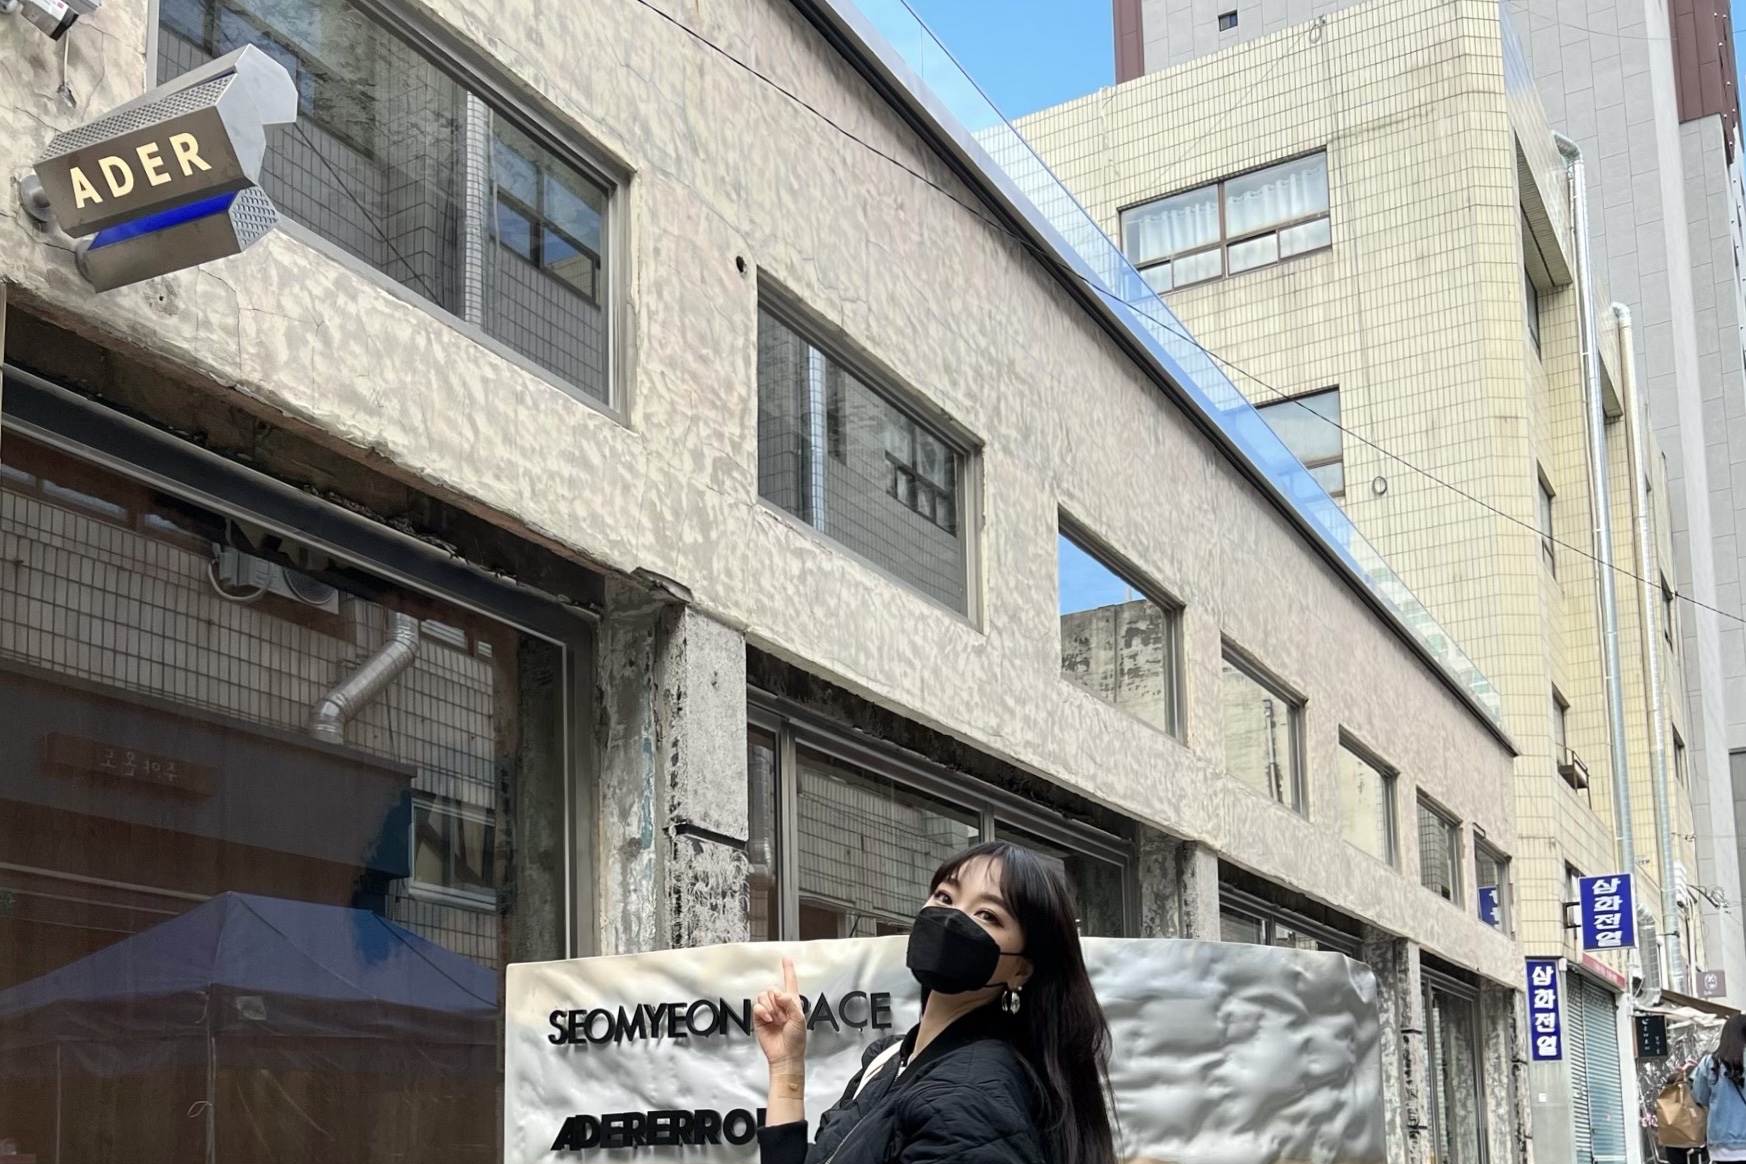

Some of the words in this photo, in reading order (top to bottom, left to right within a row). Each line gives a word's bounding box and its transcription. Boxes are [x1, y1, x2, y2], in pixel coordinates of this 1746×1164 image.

[69, 132, 213, 209] ADER
[1592, 877, 1624, 948] 삼화전열
[549, 998, 752, 1045] SEOMYEON
[1532, 965, 1558, 1056] 삼화전열
[550, 1108, 768, 1151] ADERERRO
